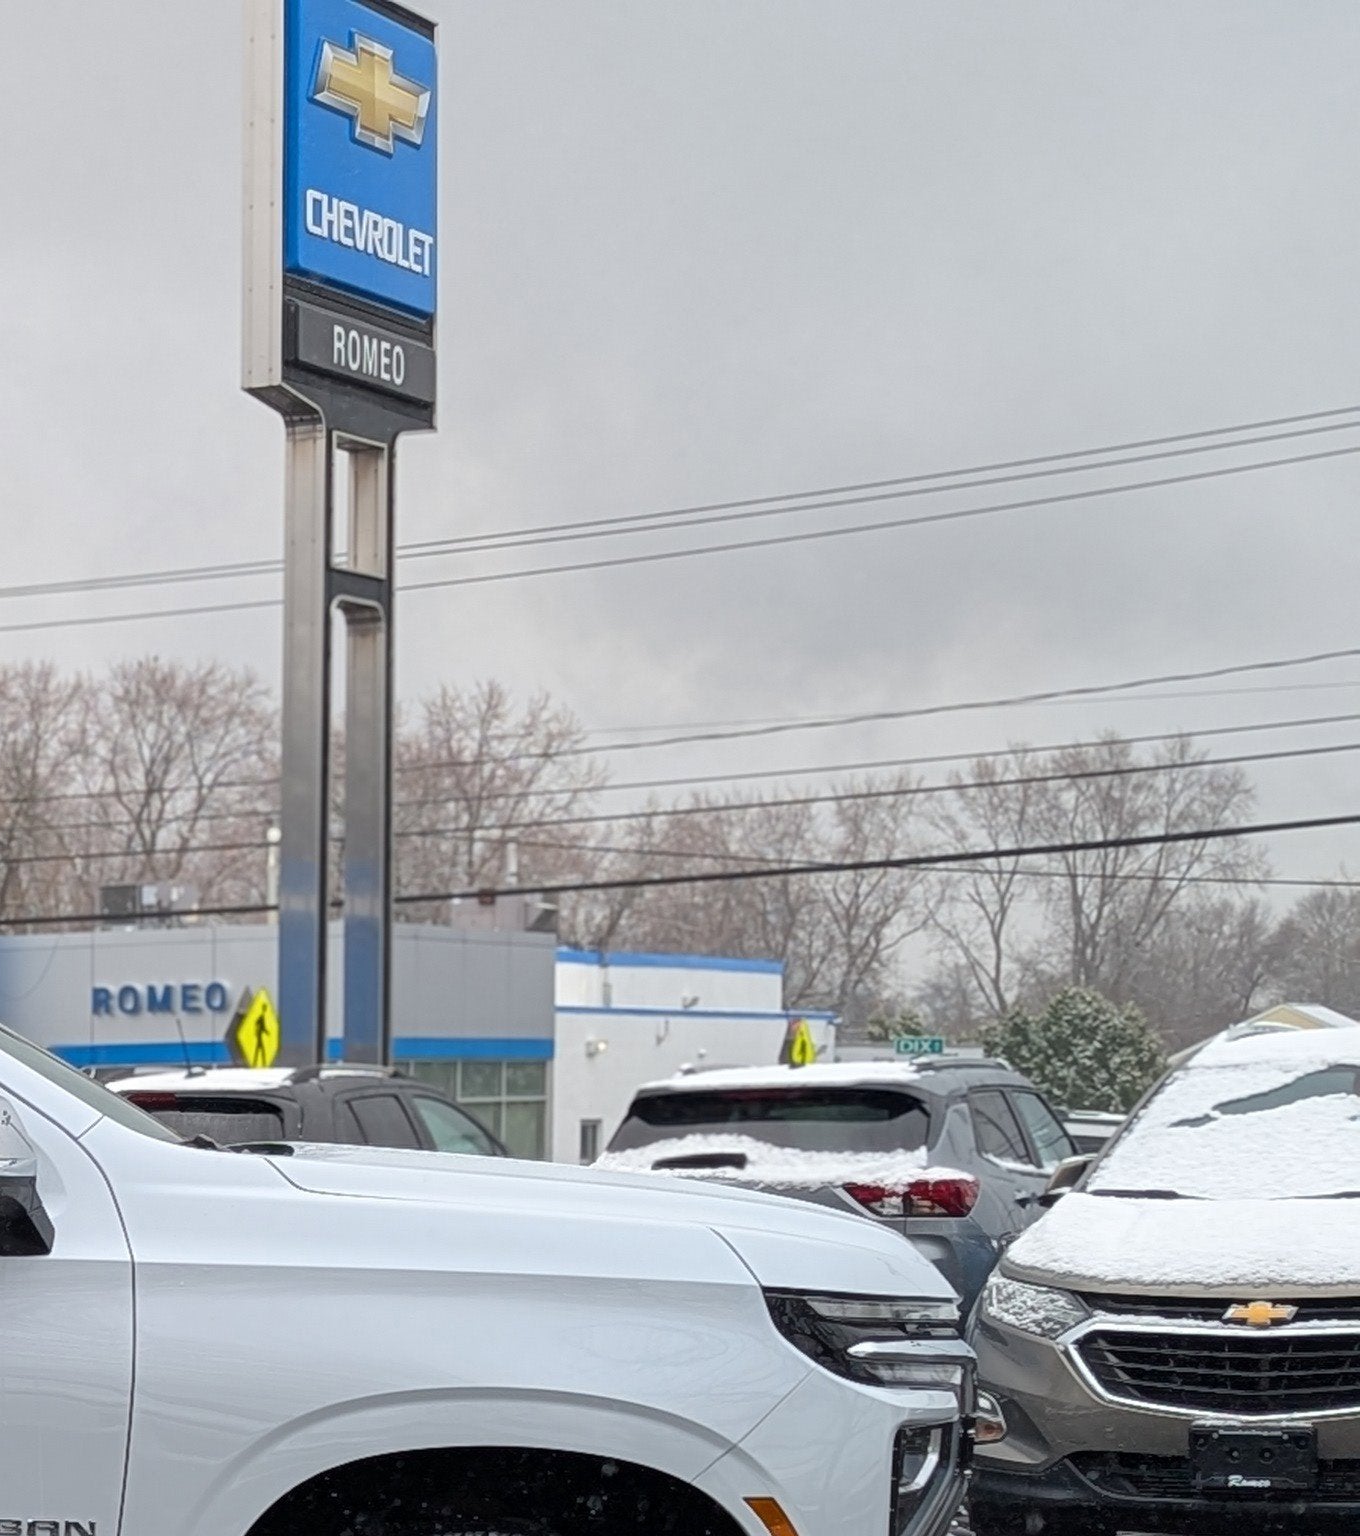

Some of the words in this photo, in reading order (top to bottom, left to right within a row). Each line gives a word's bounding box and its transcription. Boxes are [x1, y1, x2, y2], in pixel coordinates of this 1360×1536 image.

[305, 188, 433, 277] CHEVROLET
[333, 324, 405, 387] ROMEO
[91, 981, 228, 1016] ROMEO
[900, 1039, 931, 1053] DIX
